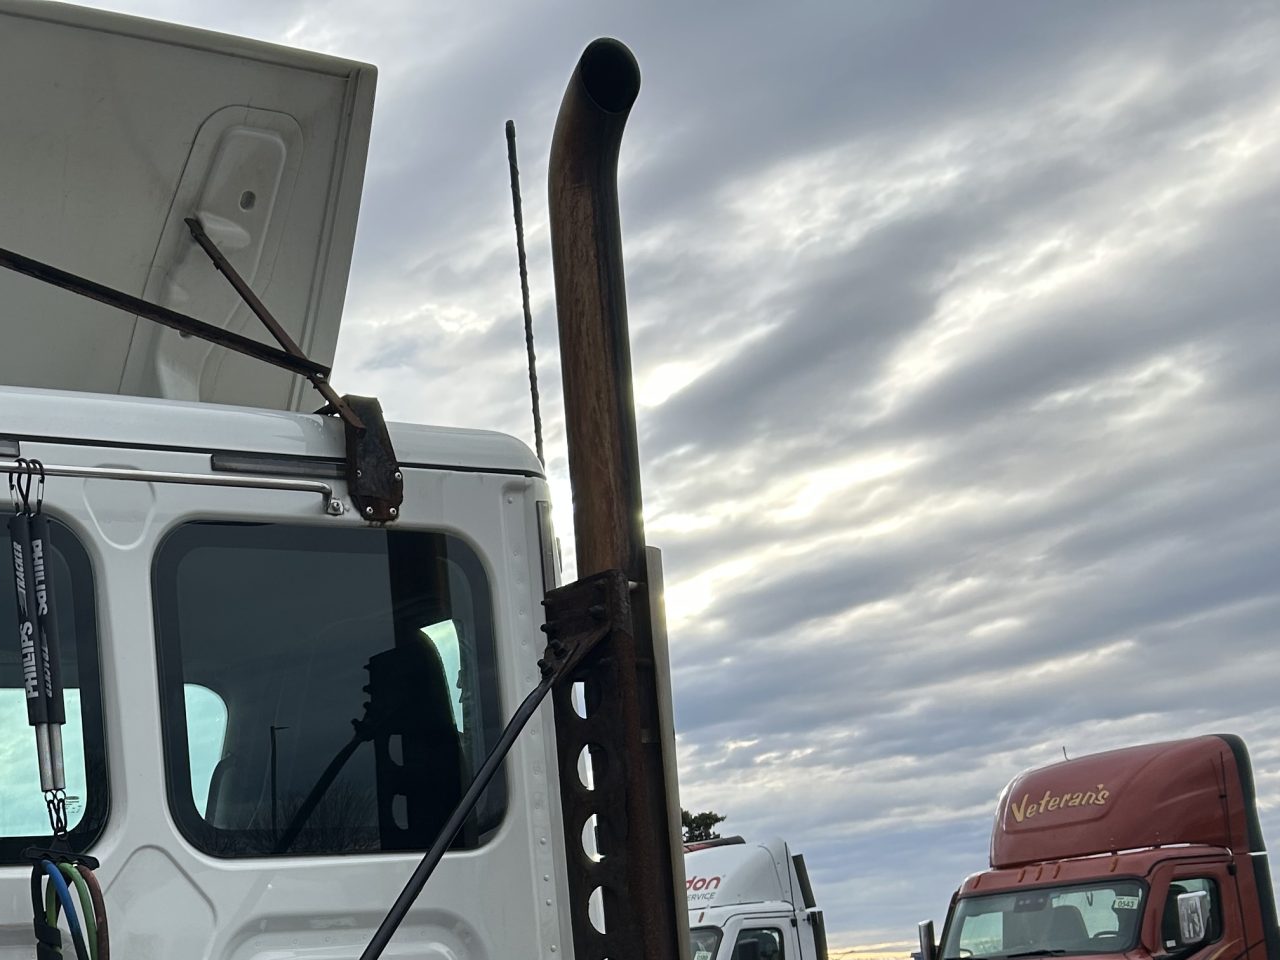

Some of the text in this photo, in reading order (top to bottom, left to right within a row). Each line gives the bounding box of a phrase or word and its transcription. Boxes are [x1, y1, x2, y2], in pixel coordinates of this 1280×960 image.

[13, 541, 39, 699] PHILLIPS TRACKER
[1010, 783, 1110, 823] Veteran's
